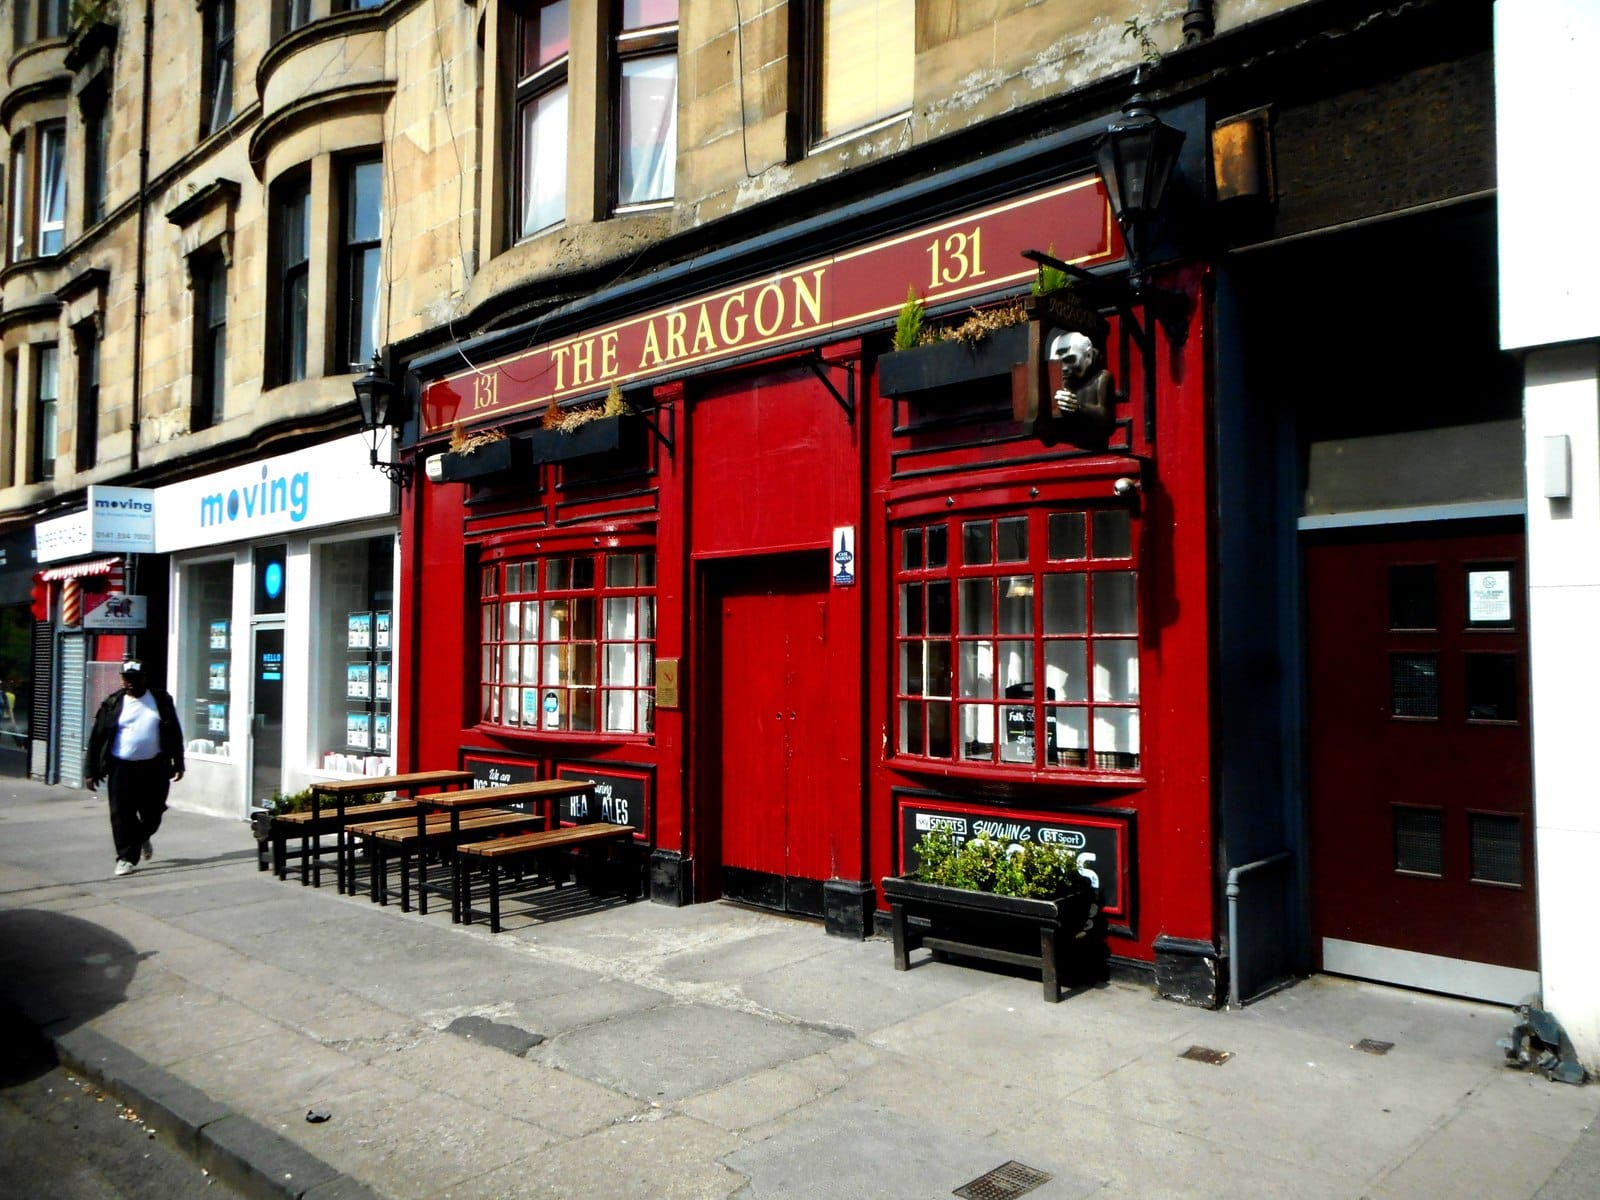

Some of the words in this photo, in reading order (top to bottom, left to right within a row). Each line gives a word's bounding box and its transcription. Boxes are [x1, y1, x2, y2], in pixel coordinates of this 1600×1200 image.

[473, 372, 500, 411] 131
[551, 330, 619, 391] THE
[638, 268, 826, 369] ARAGON
[926, 226, 986, 289] 131
[95, 498, 152, 513] moving
[200, 464, 309, 528] moving
[601, 796, 629, 825] ALES
[972, 820, 1031, 841] SHOWING
[1058, 832, 1080, 845] Sport
